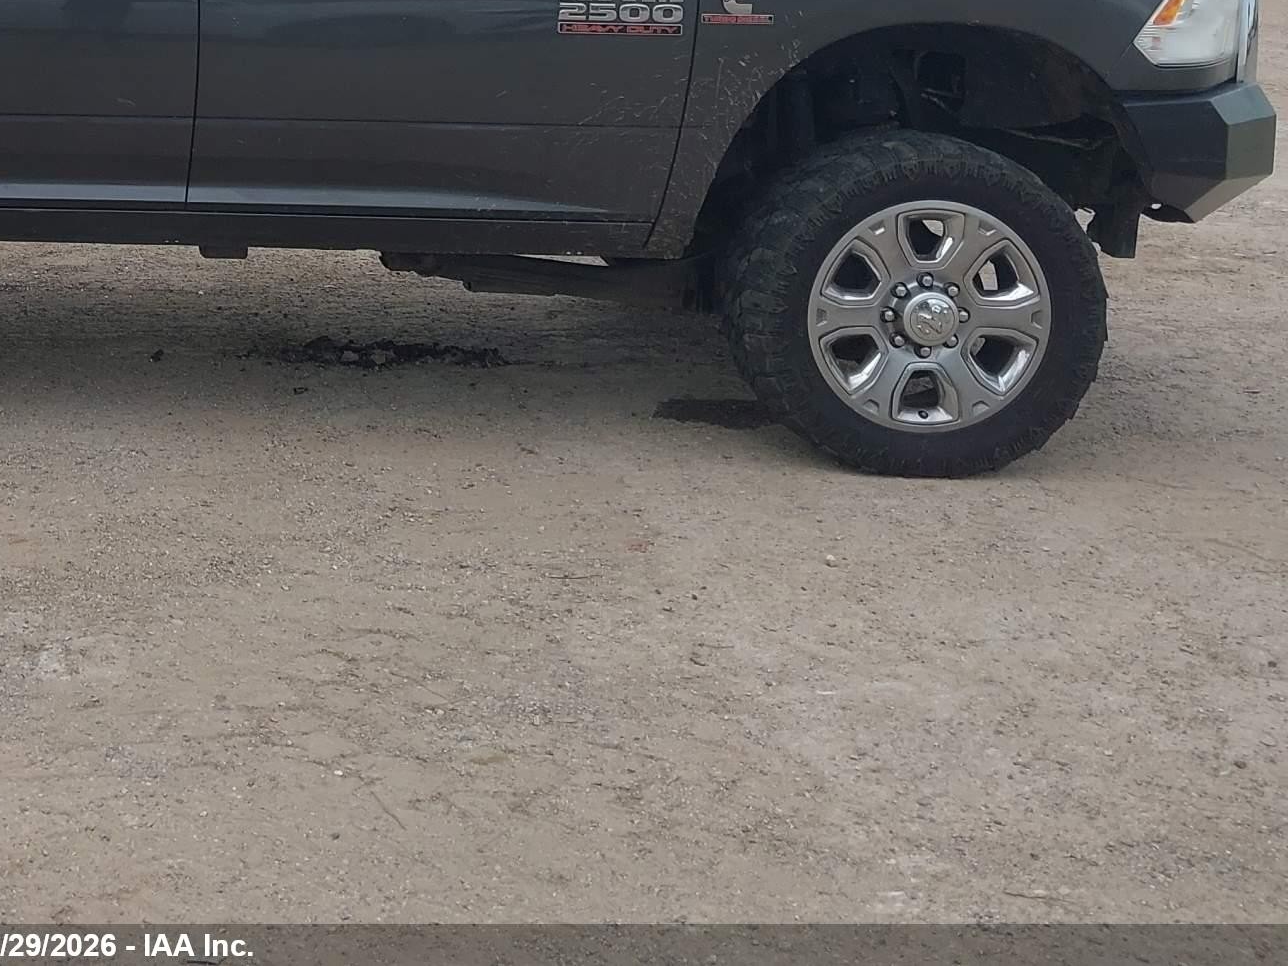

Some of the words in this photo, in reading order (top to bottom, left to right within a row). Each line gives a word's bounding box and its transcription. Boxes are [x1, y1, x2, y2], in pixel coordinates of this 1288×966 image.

[558, 2, 684, 24] 2500
[562, 23, 623, 34] HEAVY
[626, 24, 679, 35] DUTY
